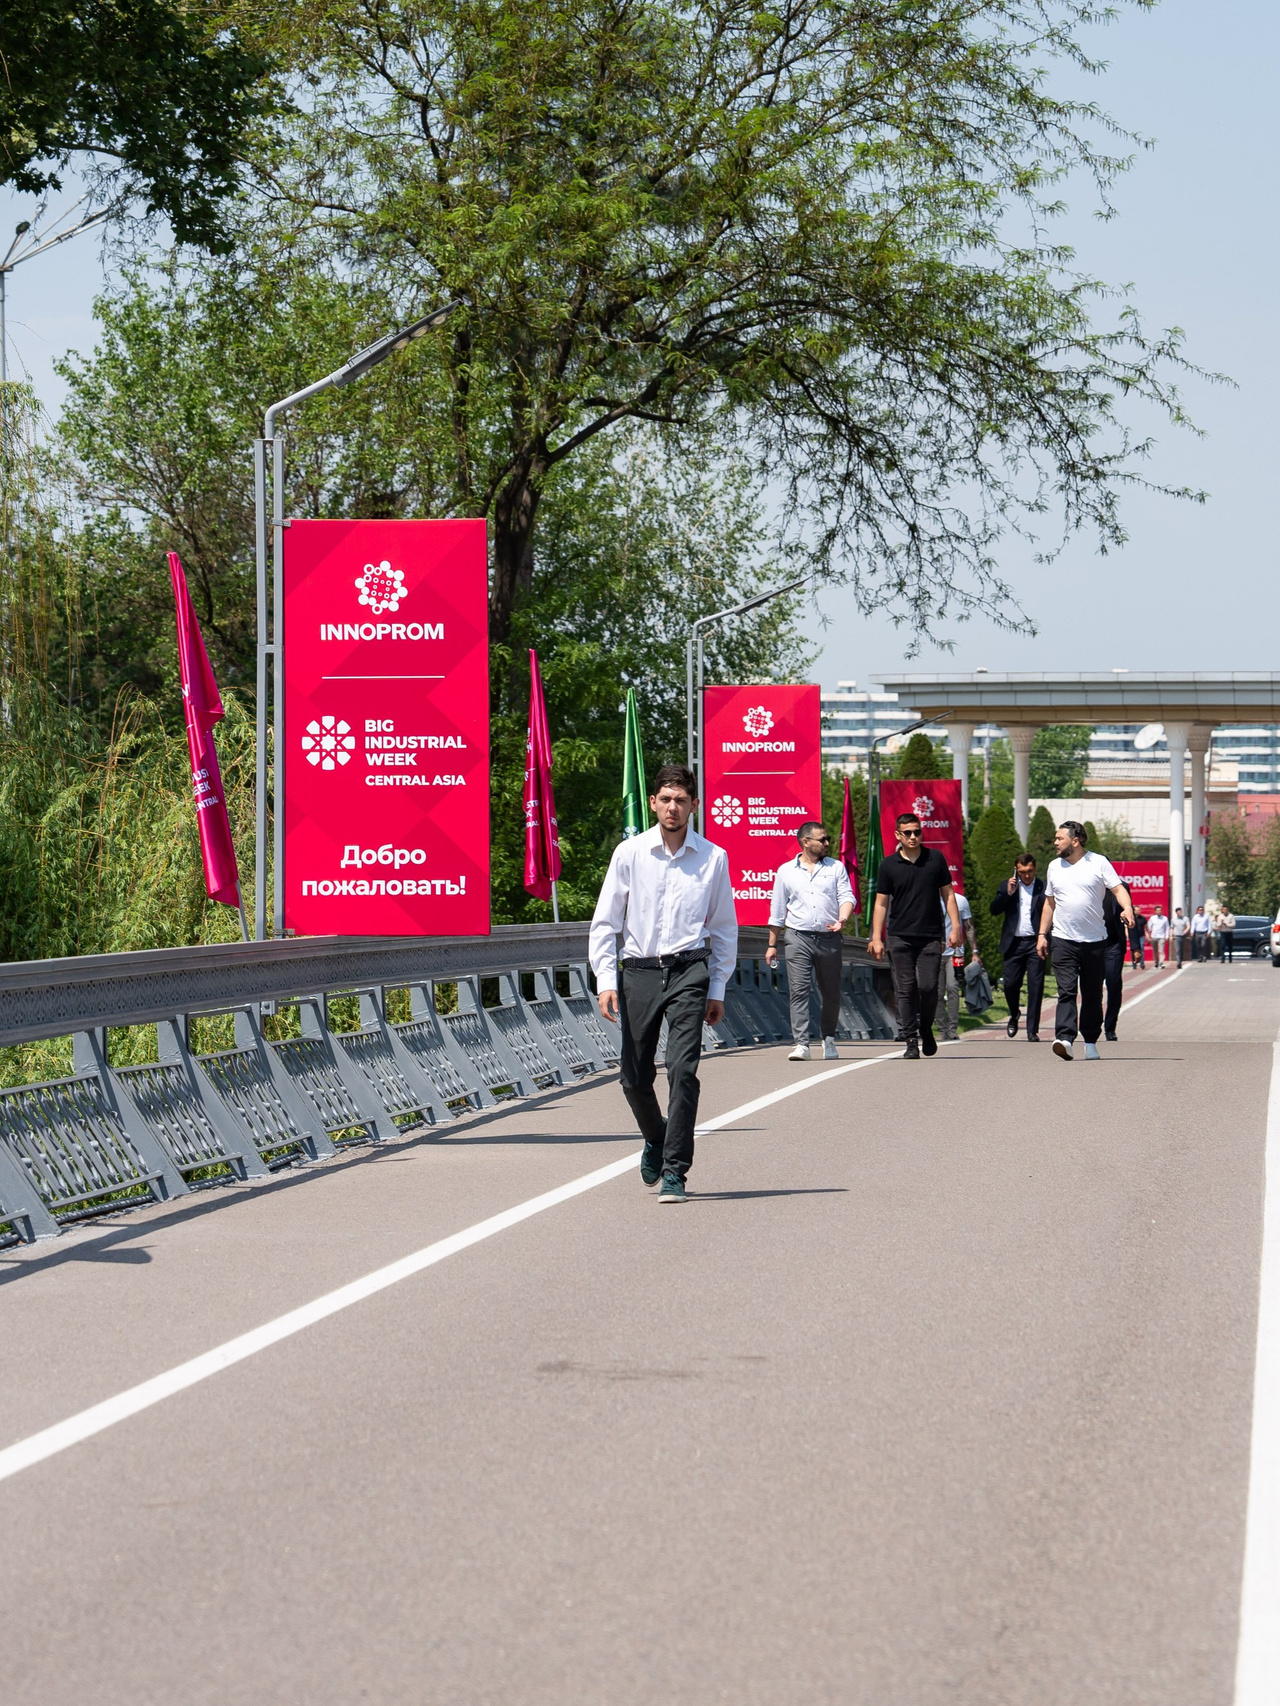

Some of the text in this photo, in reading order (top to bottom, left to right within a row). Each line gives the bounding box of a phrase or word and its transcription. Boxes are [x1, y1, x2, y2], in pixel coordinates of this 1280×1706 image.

[320, 622, 445, 641] INNOPROM
[364, 719, 394, 733] BIG
[364, 735, 467, 749] INDUSTRIAL
[722, 741, 795, 753] INNOPROM
[365, 752, 418, 766] WEEK
[365, 774, 466, 786] CENTRAL ASIA
[747, 797, 766, 806] BIG
[747, 806, 808, 815] INDUSTRIAL
[748, 816, 780, 825] WEEK
[920, 820, 948, 828] PROM
[748, 829, 799, 837] CENTRAL AS
[340, 843, 427, 870] Добро
[741, 869, 777, 882] Xush
[1120, 875, 1164, 888] PROM
[302, 875, 466, 896] пожаловать!
[732, 887, 773, 900] kelibs
